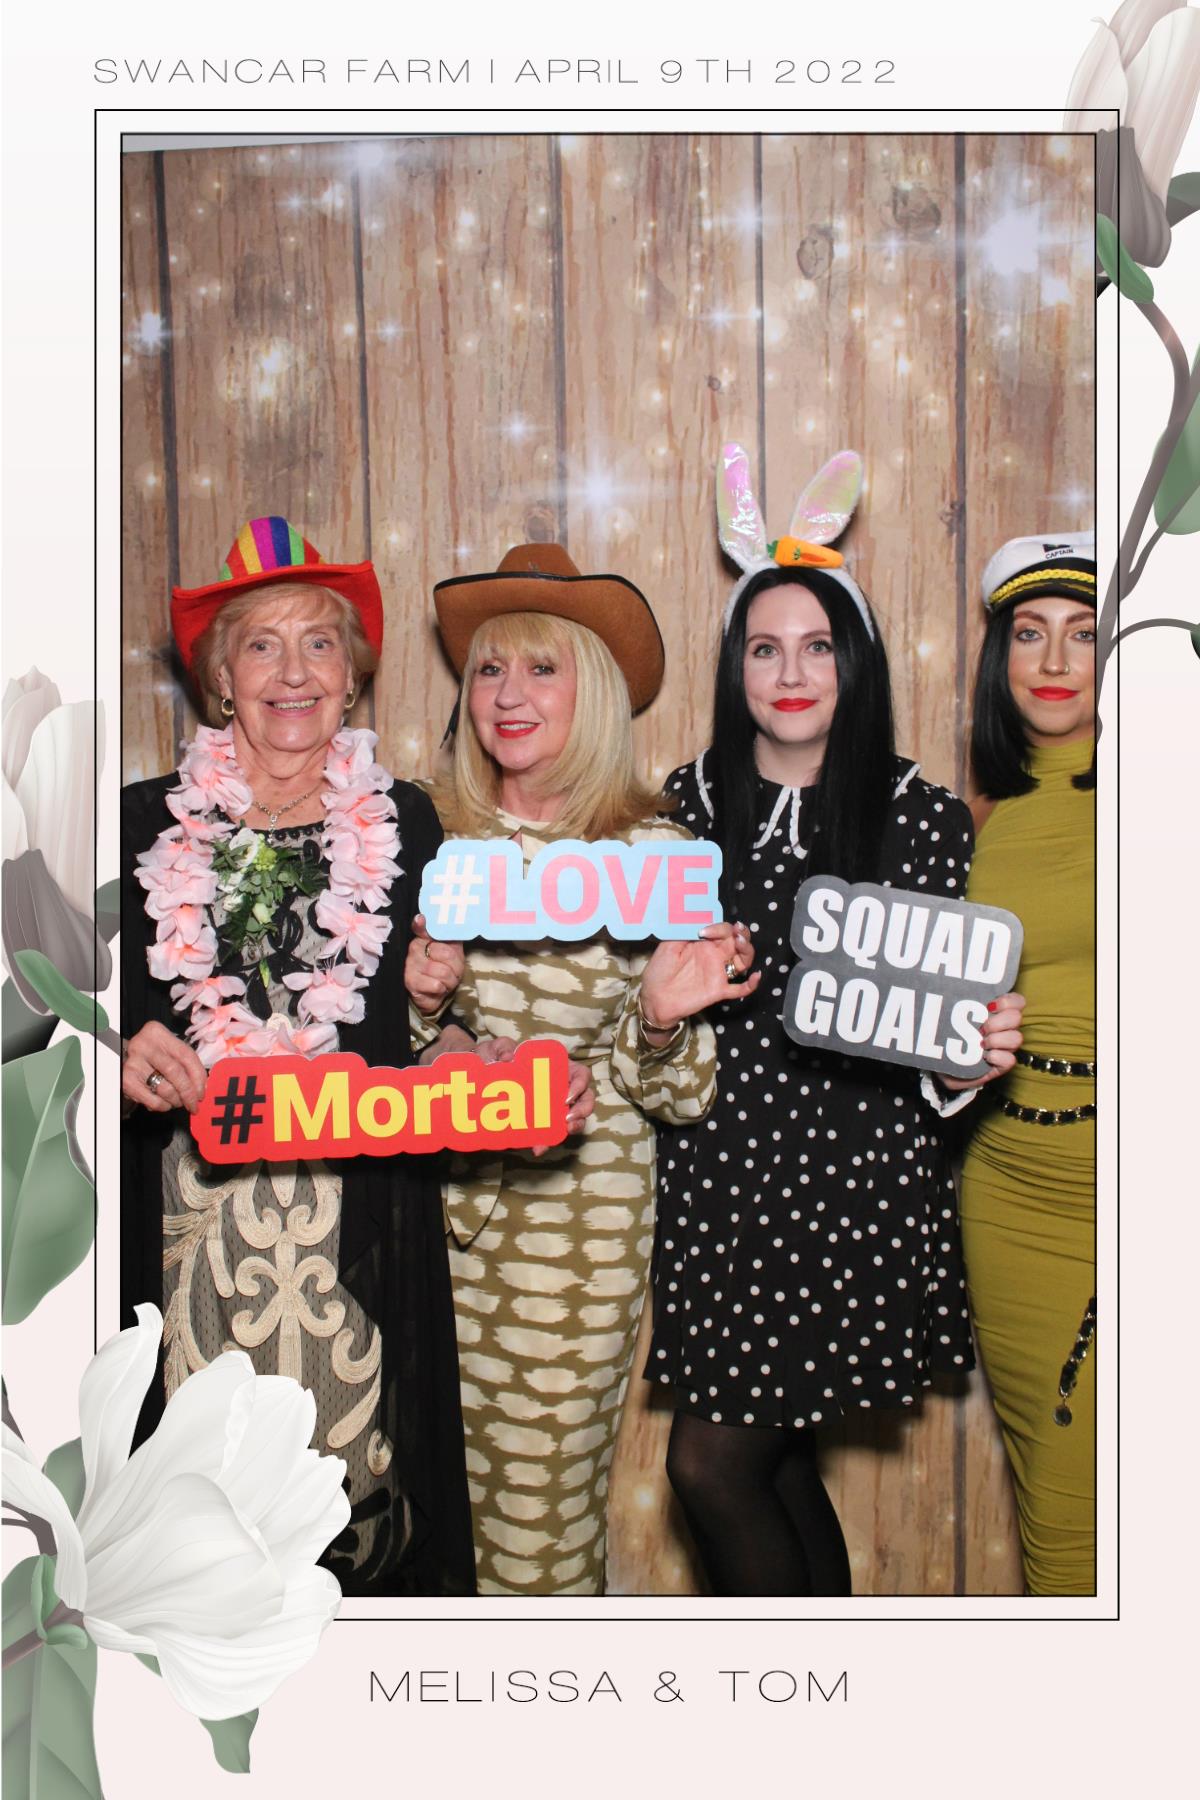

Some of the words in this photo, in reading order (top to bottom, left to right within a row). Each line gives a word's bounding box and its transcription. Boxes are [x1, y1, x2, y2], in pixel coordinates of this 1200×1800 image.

[1045, 548, 1074, 560] CAPTAIN
[429, 853, 714, 926] #LOVE
[802, 887, 1012, 985] SQUAD
[794, 969, 989, 1067] GOALS
[210, 1057, 552, 1145] #Mortal
